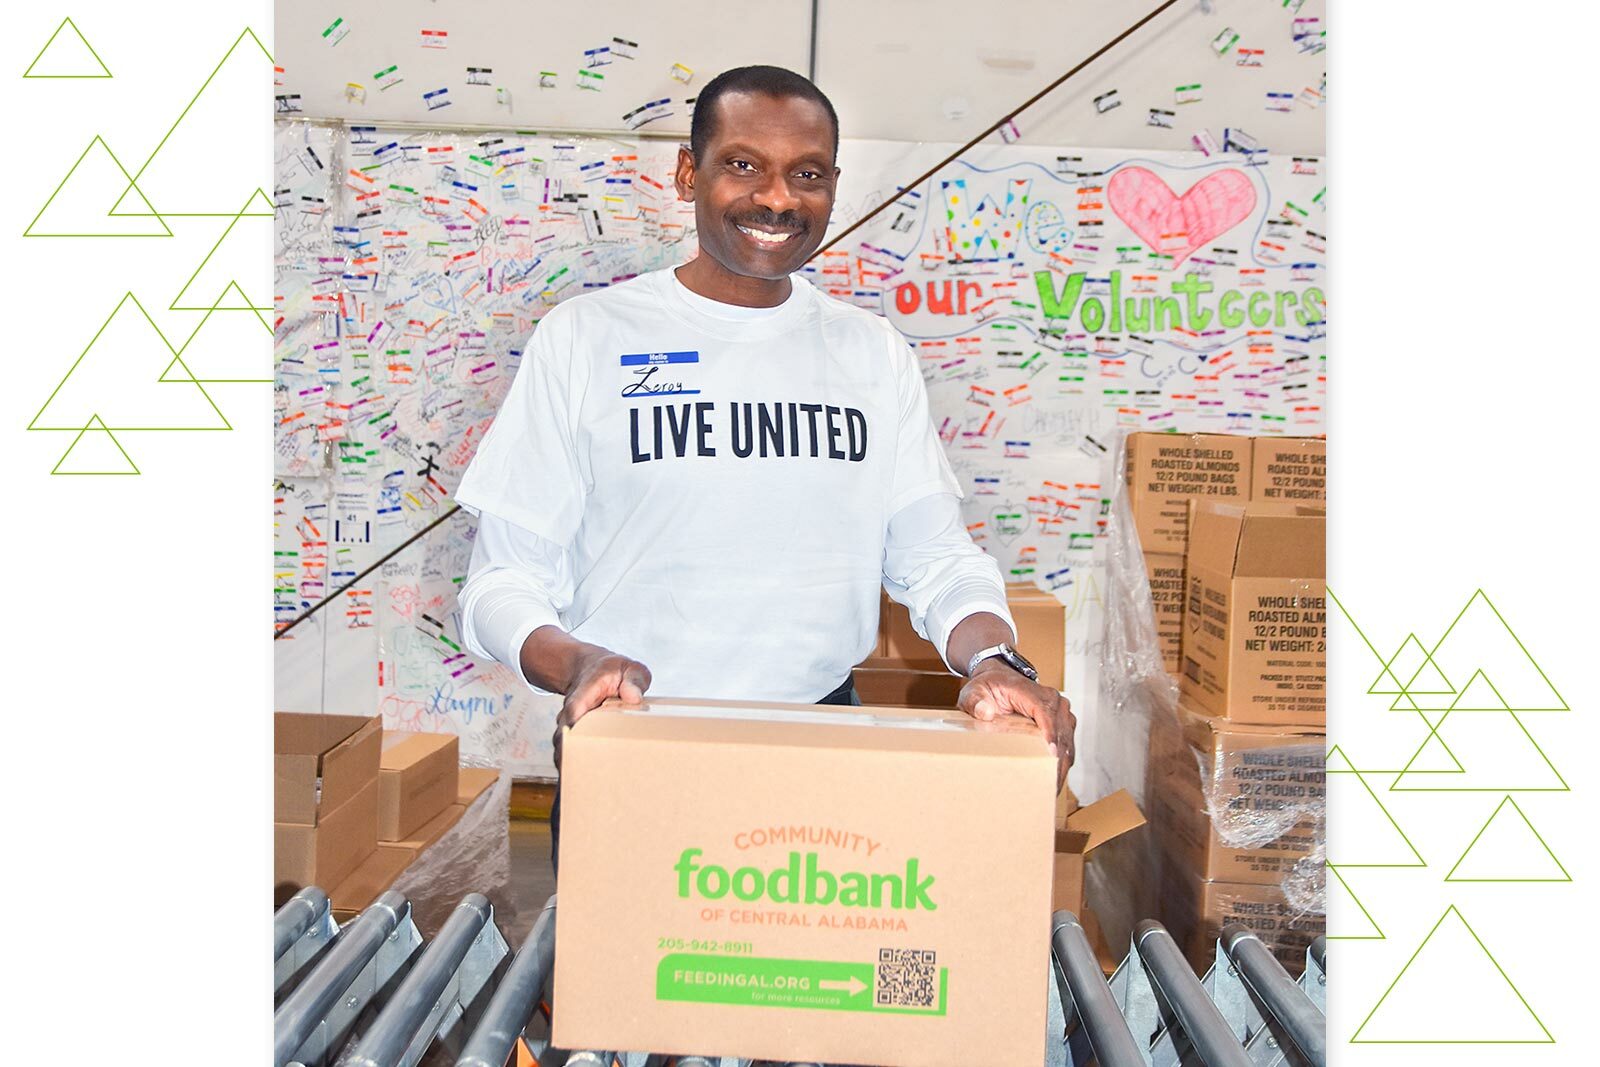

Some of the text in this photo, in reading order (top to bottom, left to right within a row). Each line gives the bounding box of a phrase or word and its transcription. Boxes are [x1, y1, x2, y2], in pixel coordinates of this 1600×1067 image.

[941, 179, 1074, 260] We
[895, 280, 983, 316] our
[649, 353, 669, 361] Hello
[621, 366, 683, 397] Leroy
[630, 402, 716, 464] LIVE
[730, 402, 868, 462] UNITED
[1159, 448, 1234, 460] WHOLE SHELLED
[1275, 453, 1309, 464] WHOLE
[1151, 459, 1240, 473] ROASTED ALMONDS
[1267, 465, 1310, 476] ROASTED
[1156, 471, 1236, 484] 12/2 POUND BAGS
[1272, 477, 1325, 488] 12/2 POUND
[1148, 483, 1165, 492] NET
[1167, 483, 1206, 494] WEIGHT:
[1207, 486, 1218, 495] 24
[1264, 488, 1320, 499] NET WEIGHT:
[1258, 596, 1298, 609] WHOLE
[1248, 610, 1300, 622] ROASTED
[1254, 625, 1277, 637] 12/2
[1279, 626, 1318, 638] POUND
[1245, 639, 1267, 651] NET
[1269, 640, 1315, 653] WEIGHT:
[1243, 753, 1286, 768] WHOLE
[1232, 766, 1286, 781] ROASTED
[1265, 784, 1305, 797] POUND
[734, 826, 882, 857] COMMUNITY
[674, 848, 938, 911] foodbank
[700, 908, 909, 933] OF CENTRAL ALABAMA
[657, 937, 754, 954] 205-942-8911
[673, 969, 811, 991] FEEDINGAL.ORG
[751, 991, 841, 1006] for more resources
